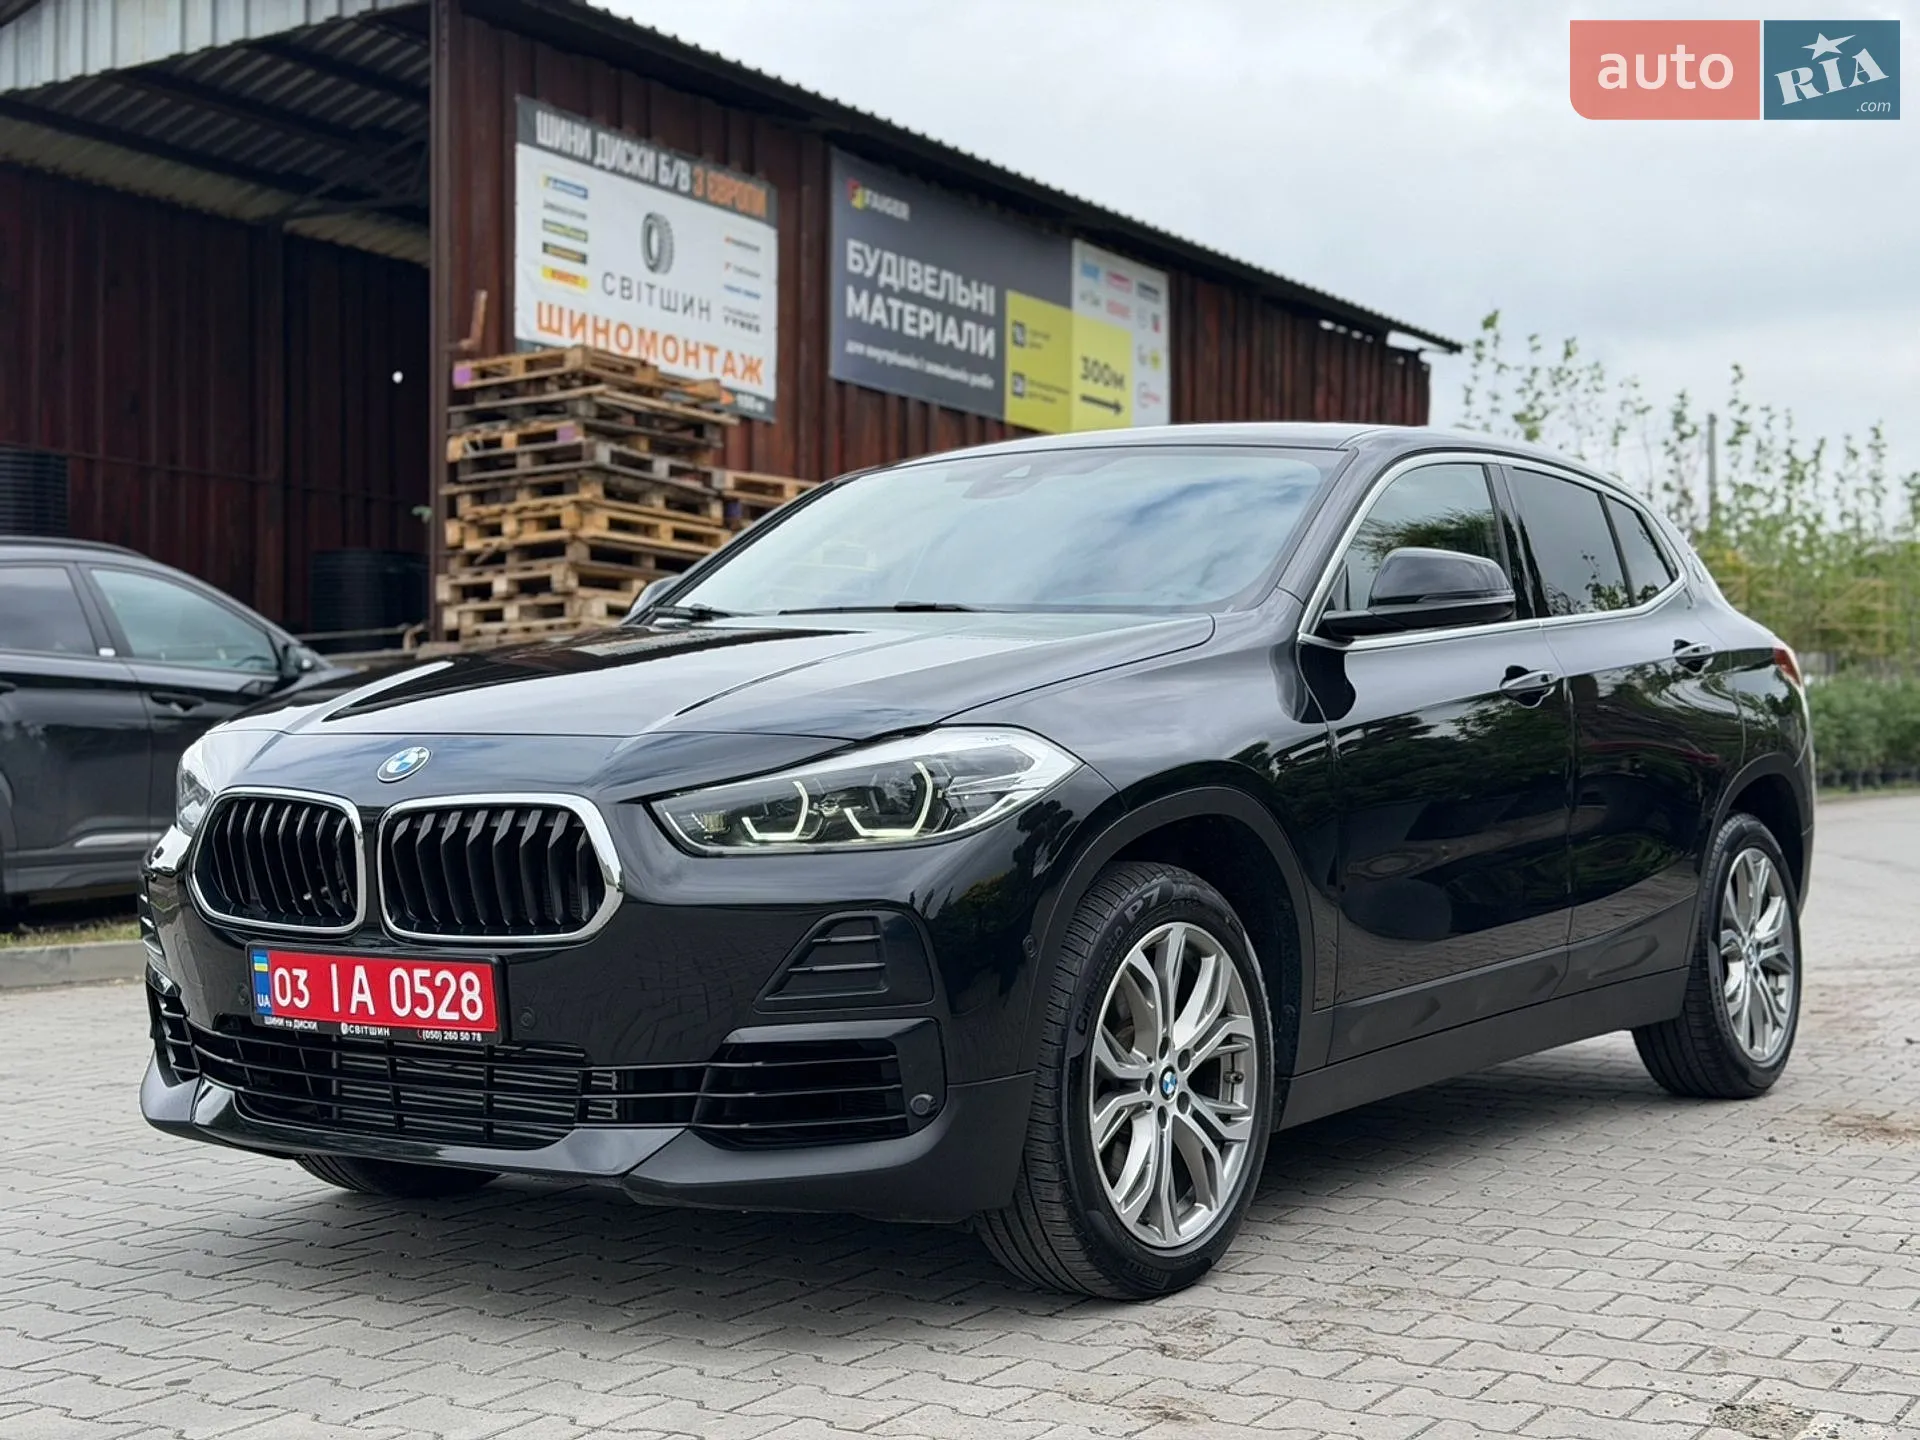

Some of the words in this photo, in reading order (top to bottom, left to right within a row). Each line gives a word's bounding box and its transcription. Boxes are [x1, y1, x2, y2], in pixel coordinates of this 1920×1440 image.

[535, 110, 592, 161] ШИНИ
[593, 132, 656, 182] ДИСКИ
[658, 153, 691, 193] Б/В
[692, 165, 705, 198] З
[601, 271, 712, 323] СВІТШИН
[845, 238, 996, 317] БУДІВЕЛЬНІ
[536, 301, 764, 386] ШИНОМОНТАЖ
[845, 285, 996, 361] МАТЕРІАЛИ
[1123, 886, 1161, 924] P7
[257, 993, 272, 1008] UA
[273, 966, 311, 1009] 03
[388, 966, 484, 1022] 0528
[349, 1024, 391, 1037] СВІТШИН
[422, 1029, 443, 1041] (050)
